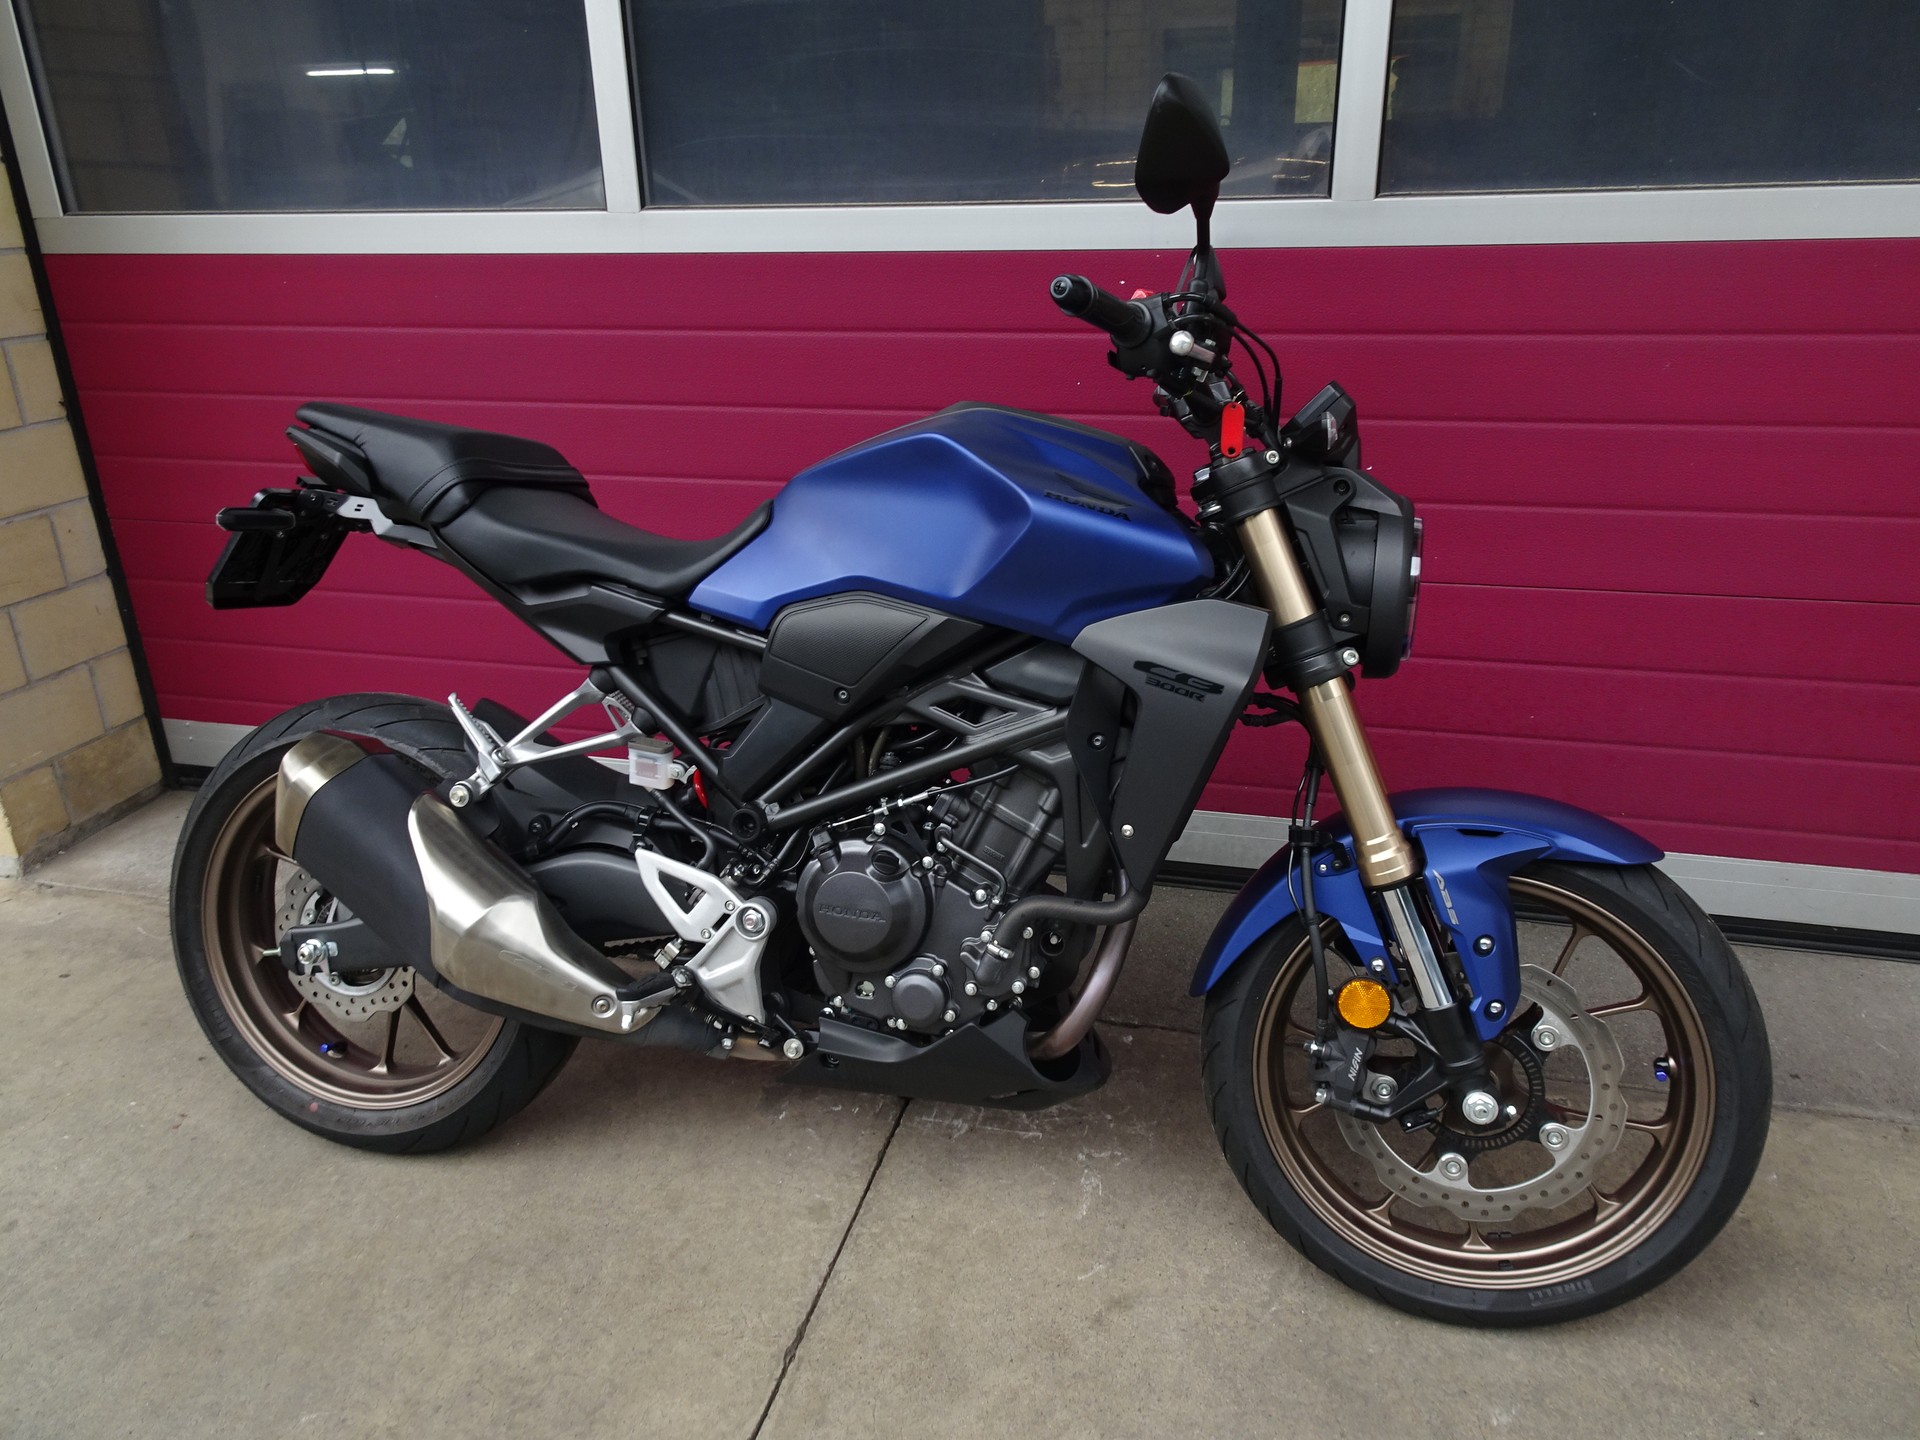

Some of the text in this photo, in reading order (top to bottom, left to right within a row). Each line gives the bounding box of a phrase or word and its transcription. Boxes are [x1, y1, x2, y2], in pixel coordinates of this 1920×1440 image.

[1145, 676, 1205, 703] 300R
[1432, 869, 1460, 926] ABS
[819, 904, 886, 923] HONDA
